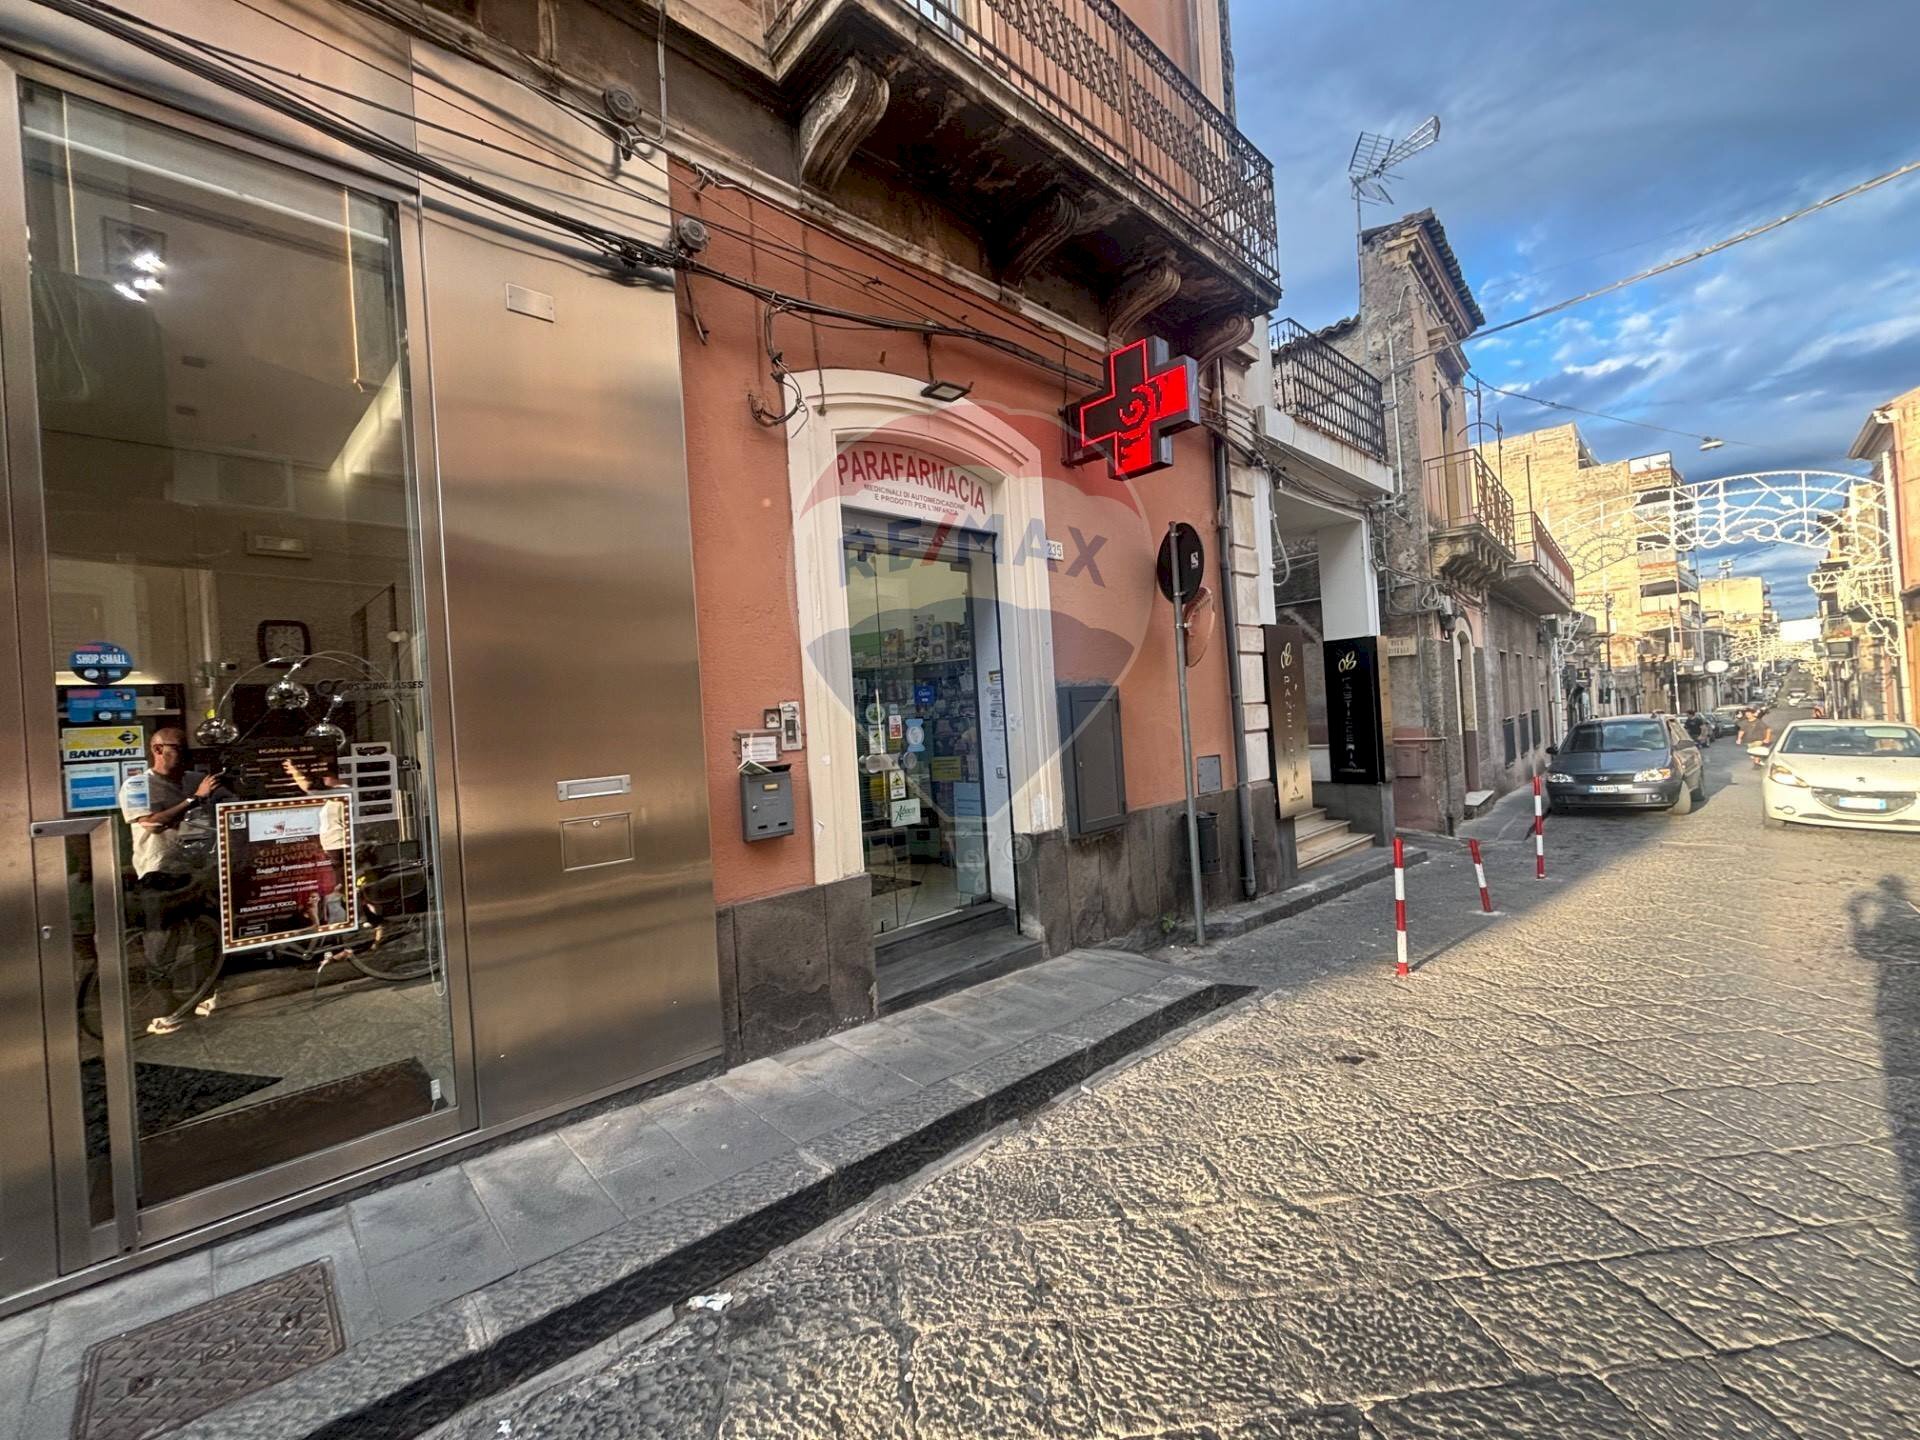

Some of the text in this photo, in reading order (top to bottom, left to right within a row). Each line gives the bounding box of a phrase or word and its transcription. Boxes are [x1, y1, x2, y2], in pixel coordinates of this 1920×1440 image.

[837, 451, 986, 515] PARAFARMACIA
[863, 484, 902, 497] MEDICINALI
[911, 492, 966, 511] AUTOMEDICAZIONE
[874, 493, 880, 501] E
[881, 495, 913, 508] PRODOTTI
[914, 500, 927, 510] PER
[1047, 542, 1062, 557] 235
[76, 654, 128, 665] SHOP SMALL
[69, 747, 138, 759] BANCOMAT
